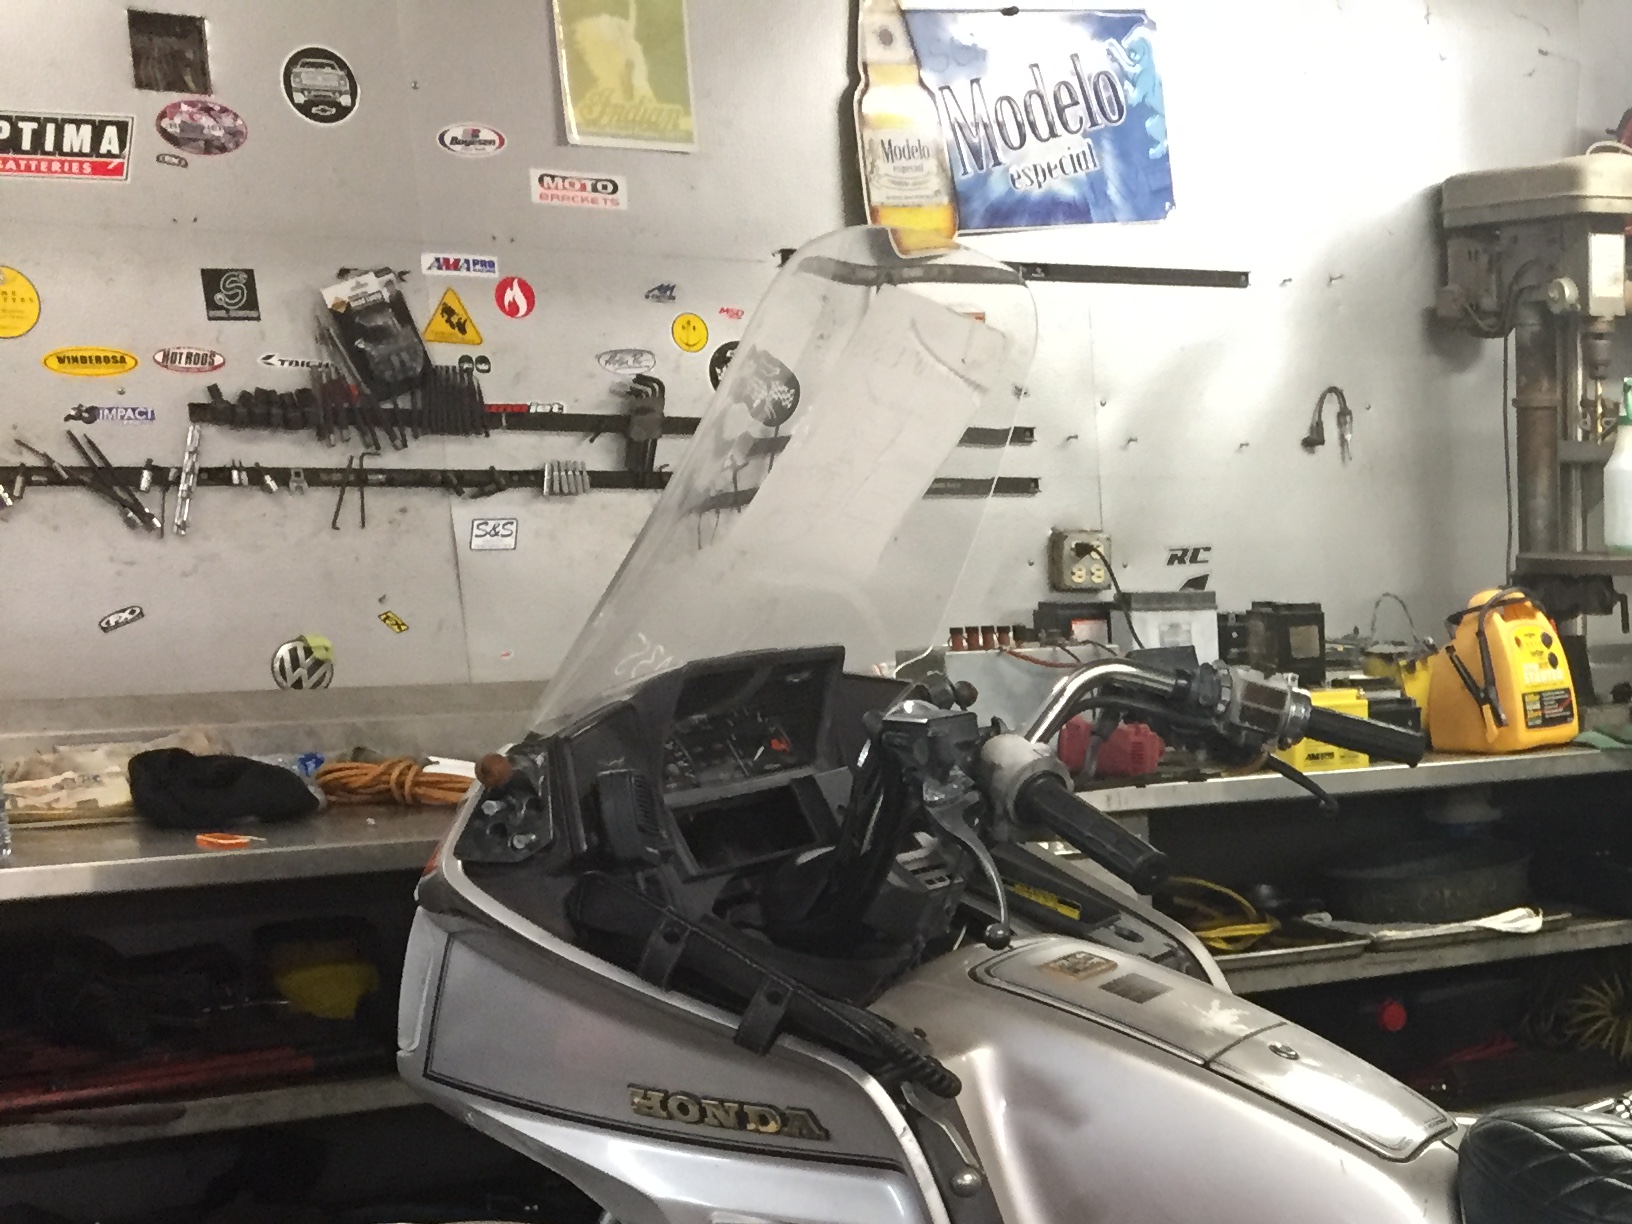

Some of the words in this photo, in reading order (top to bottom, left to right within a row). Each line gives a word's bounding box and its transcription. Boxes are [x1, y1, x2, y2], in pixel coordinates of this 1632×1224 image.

[938, 53, 1127, 176] Modelo
[880, 138, 931, 163] Modelo
[1009, 139, 1100, 190] especial
[542, 175, 614, 195] MOTO
[538, 192, 620, 208] BRACKETS
[427, 257, 471, 272] AMA
[56, 355, 127, 365] WINDEROSA
[161, 348, 183, 366] HOT
[184, 350, 216, 367] RODS
[99, 406, 153, 421] IMPACT
[474, 520, 515, 538] S&S
[1166, 546, 1212, 566] RC
[626, 1083, 831, 1142] HONDA
